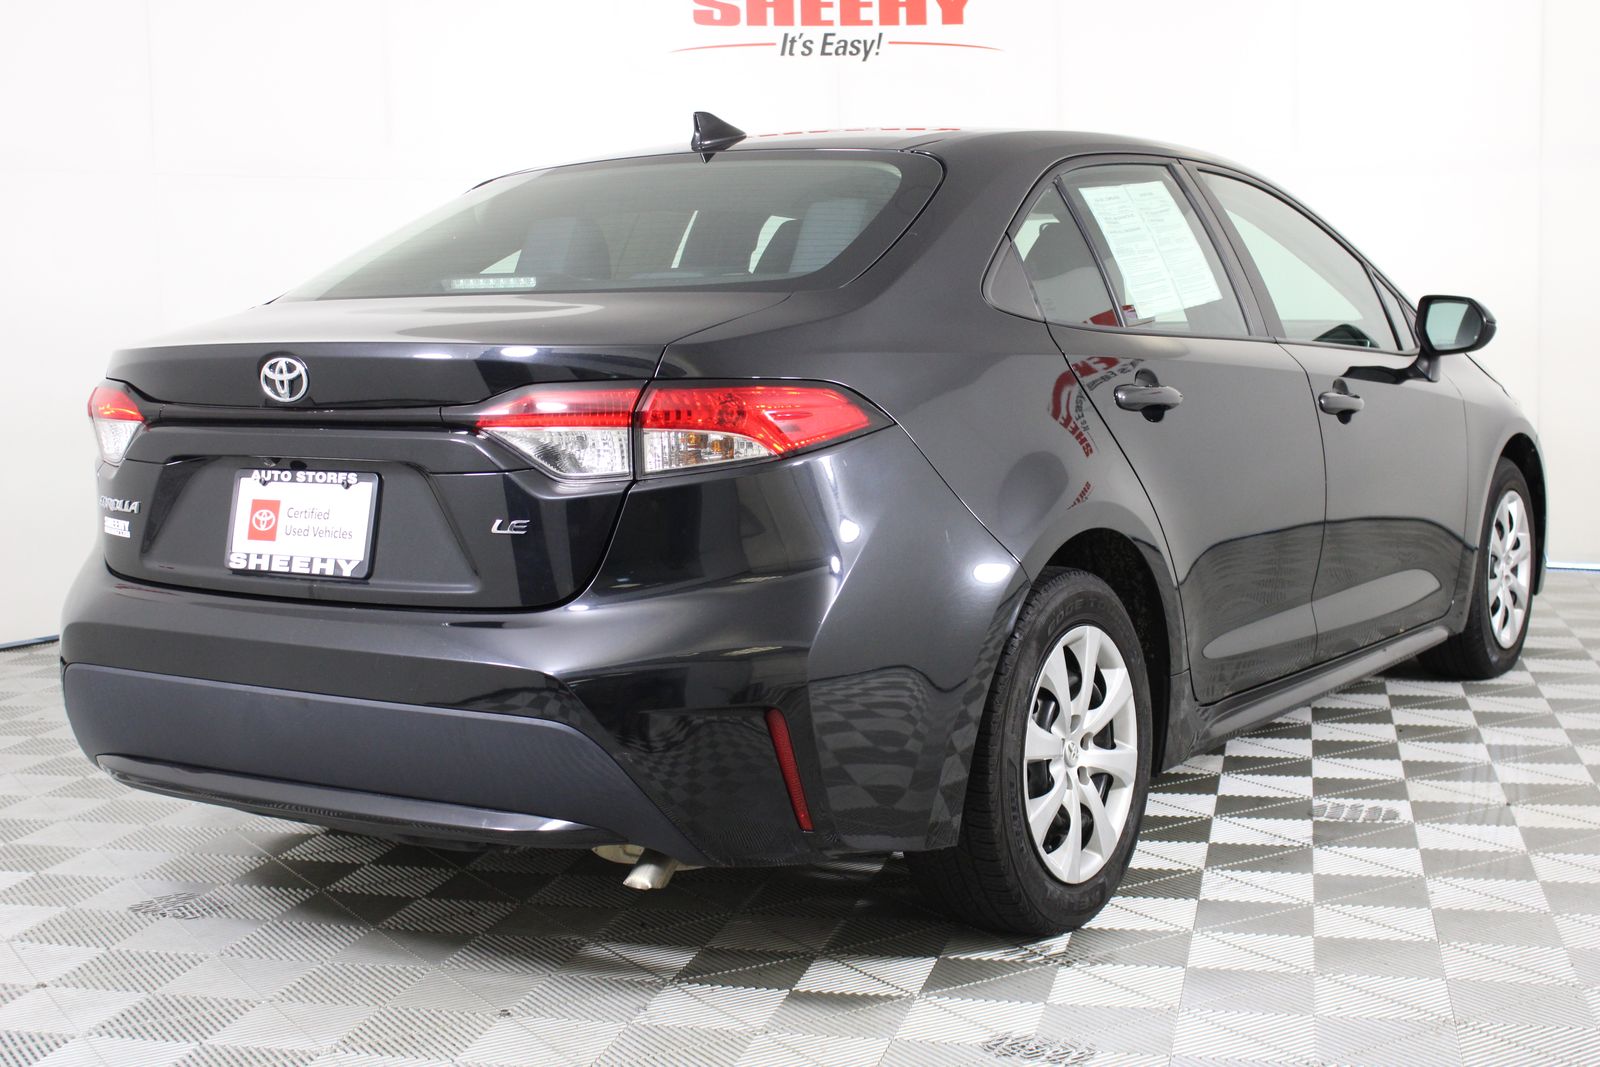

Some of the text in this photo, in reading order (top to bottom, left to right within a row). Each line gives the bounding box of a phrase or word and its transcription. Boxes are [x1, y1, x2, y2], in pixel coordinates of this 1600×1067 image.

[693, 0, 969, 26] SHEEHY
[780, 32, 883, 61] It's Easy!
[251, 470, 292, 482] AUTO
[287, 507, 331, 520] Certified
[284, 525, 353, 540] Used Vehicles
[491, 519, 530, 535] LE
[229, 552, 361, 577] SHEEHY
